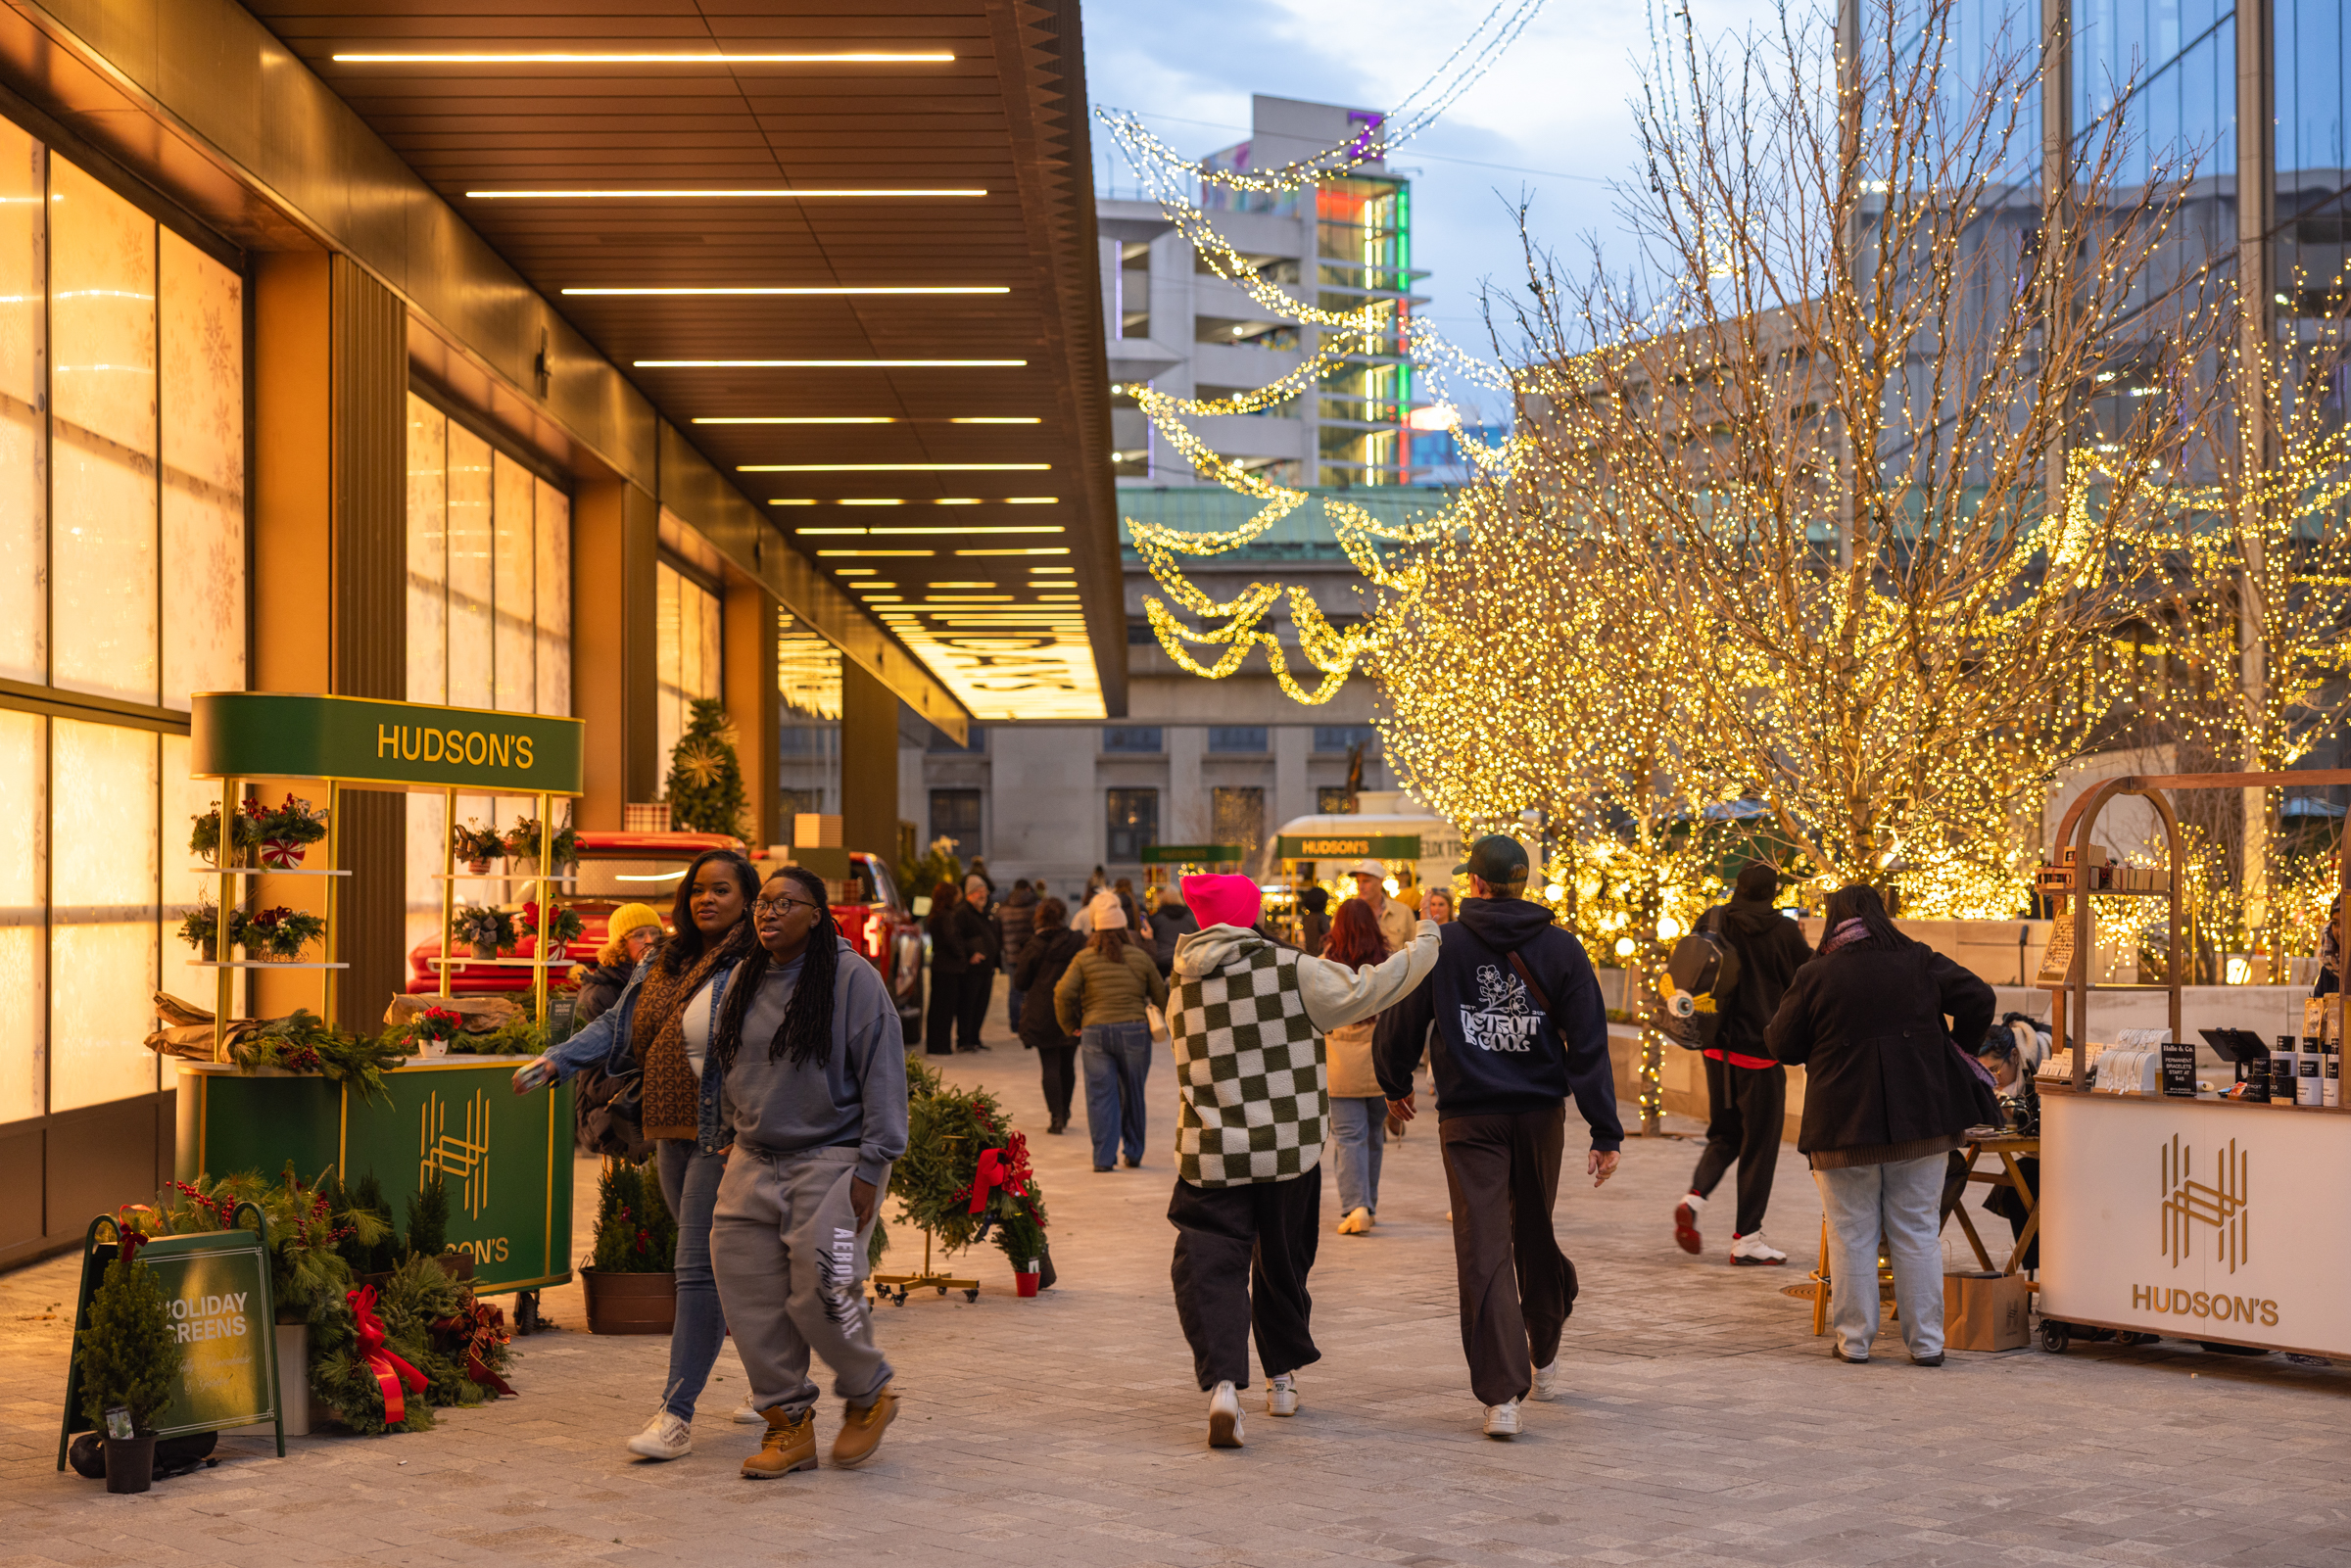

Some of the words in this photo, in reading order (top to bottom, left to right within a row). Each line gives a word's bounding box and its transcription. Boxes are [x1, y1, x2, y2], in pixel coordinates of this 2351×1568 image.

[377, 724, 534, 770] HUDSON'S
[1301, 839, 1369, 855] HUDSON'S
[1460, 1009, 1541, 1035] DETROIT
[1477, 1030, 1531, 1052] COOL
[2133, 1284, 2279, 1326] HUDSON'S
